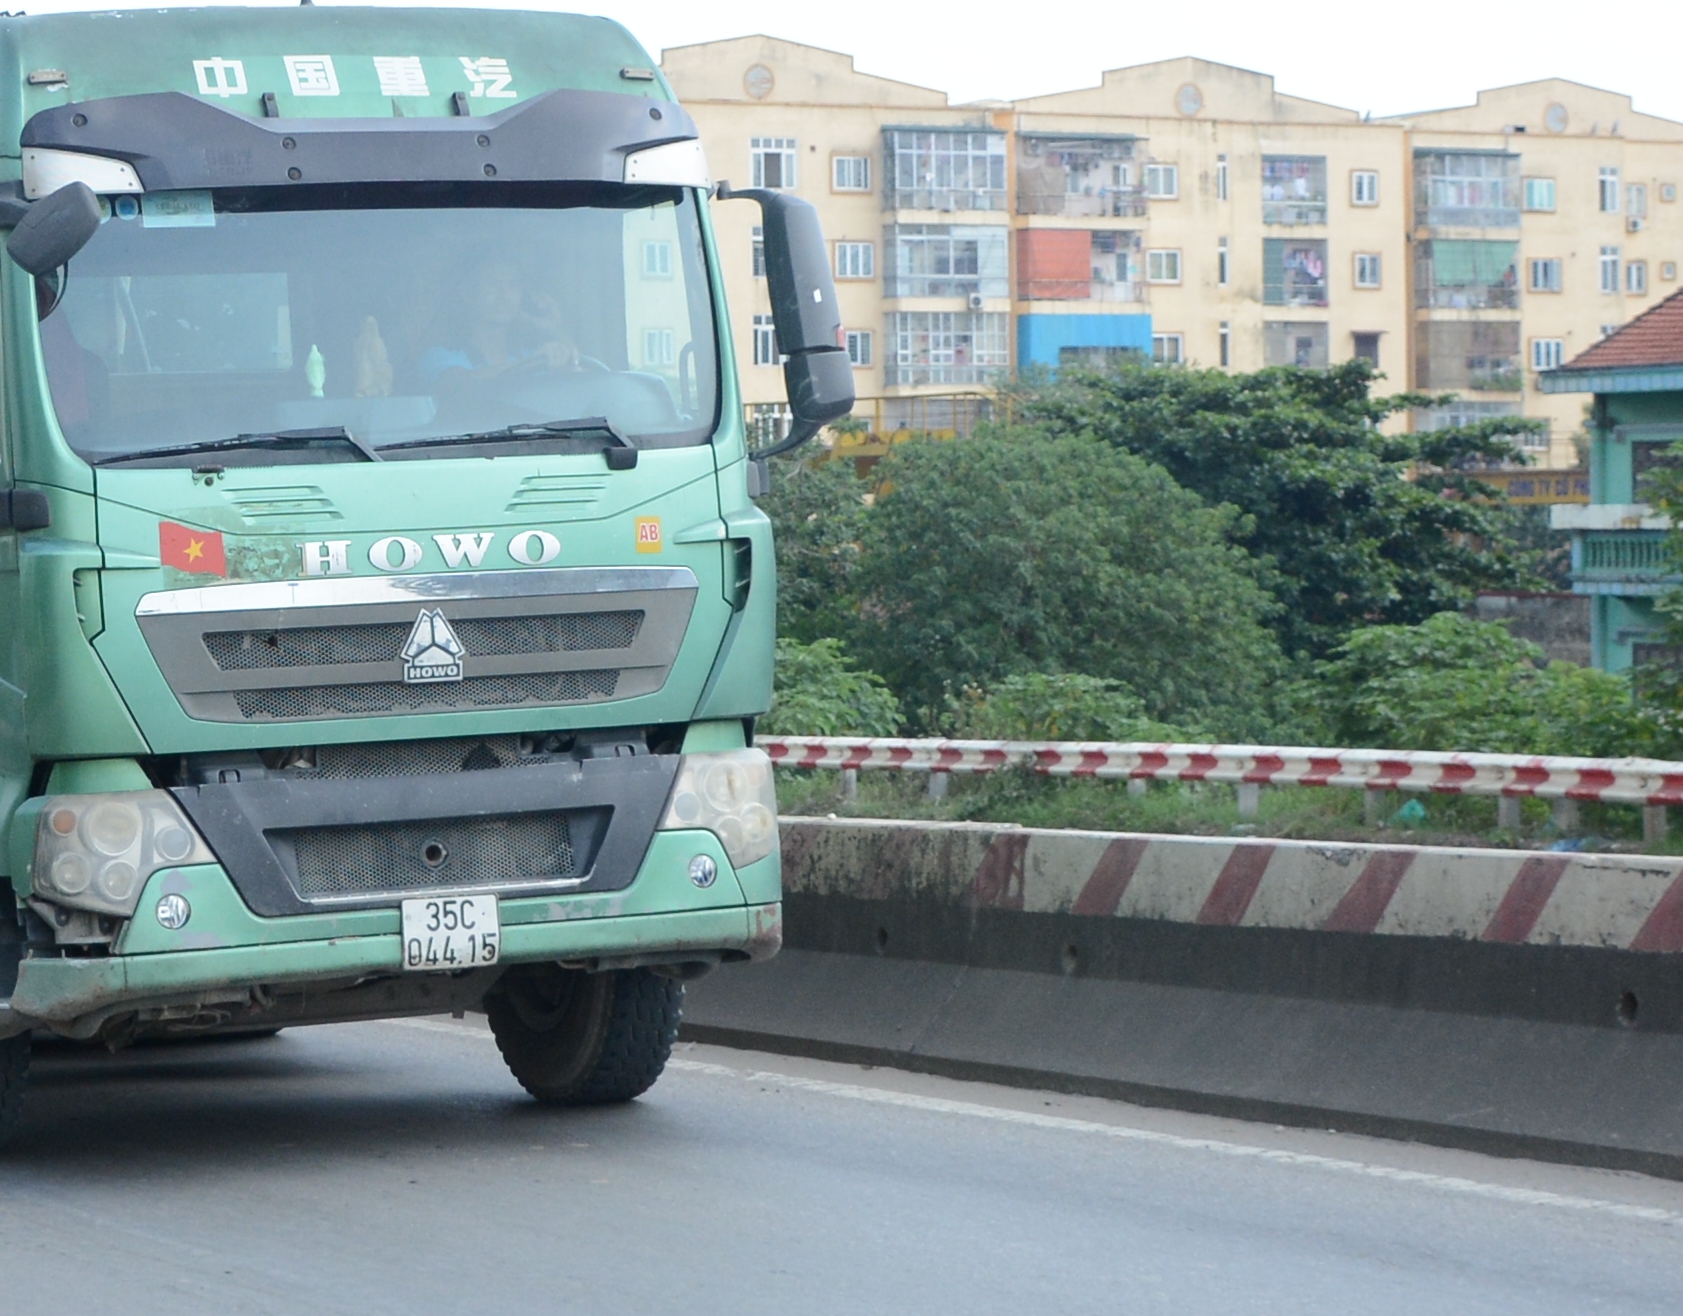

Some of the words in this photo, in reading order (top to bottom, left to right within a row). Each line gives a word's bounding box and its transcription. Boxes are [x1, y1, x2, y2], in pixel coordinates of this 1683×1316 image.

[192, 55, 517, 98] 中国重汽
[639, 523, 659, 542] AB
[296, 530, 561, 576] HOWO
[409, 665, 458, 679] HOWO
[425, 899, 476, 932] 35C
[407, 933, 497, 967] 044.15
